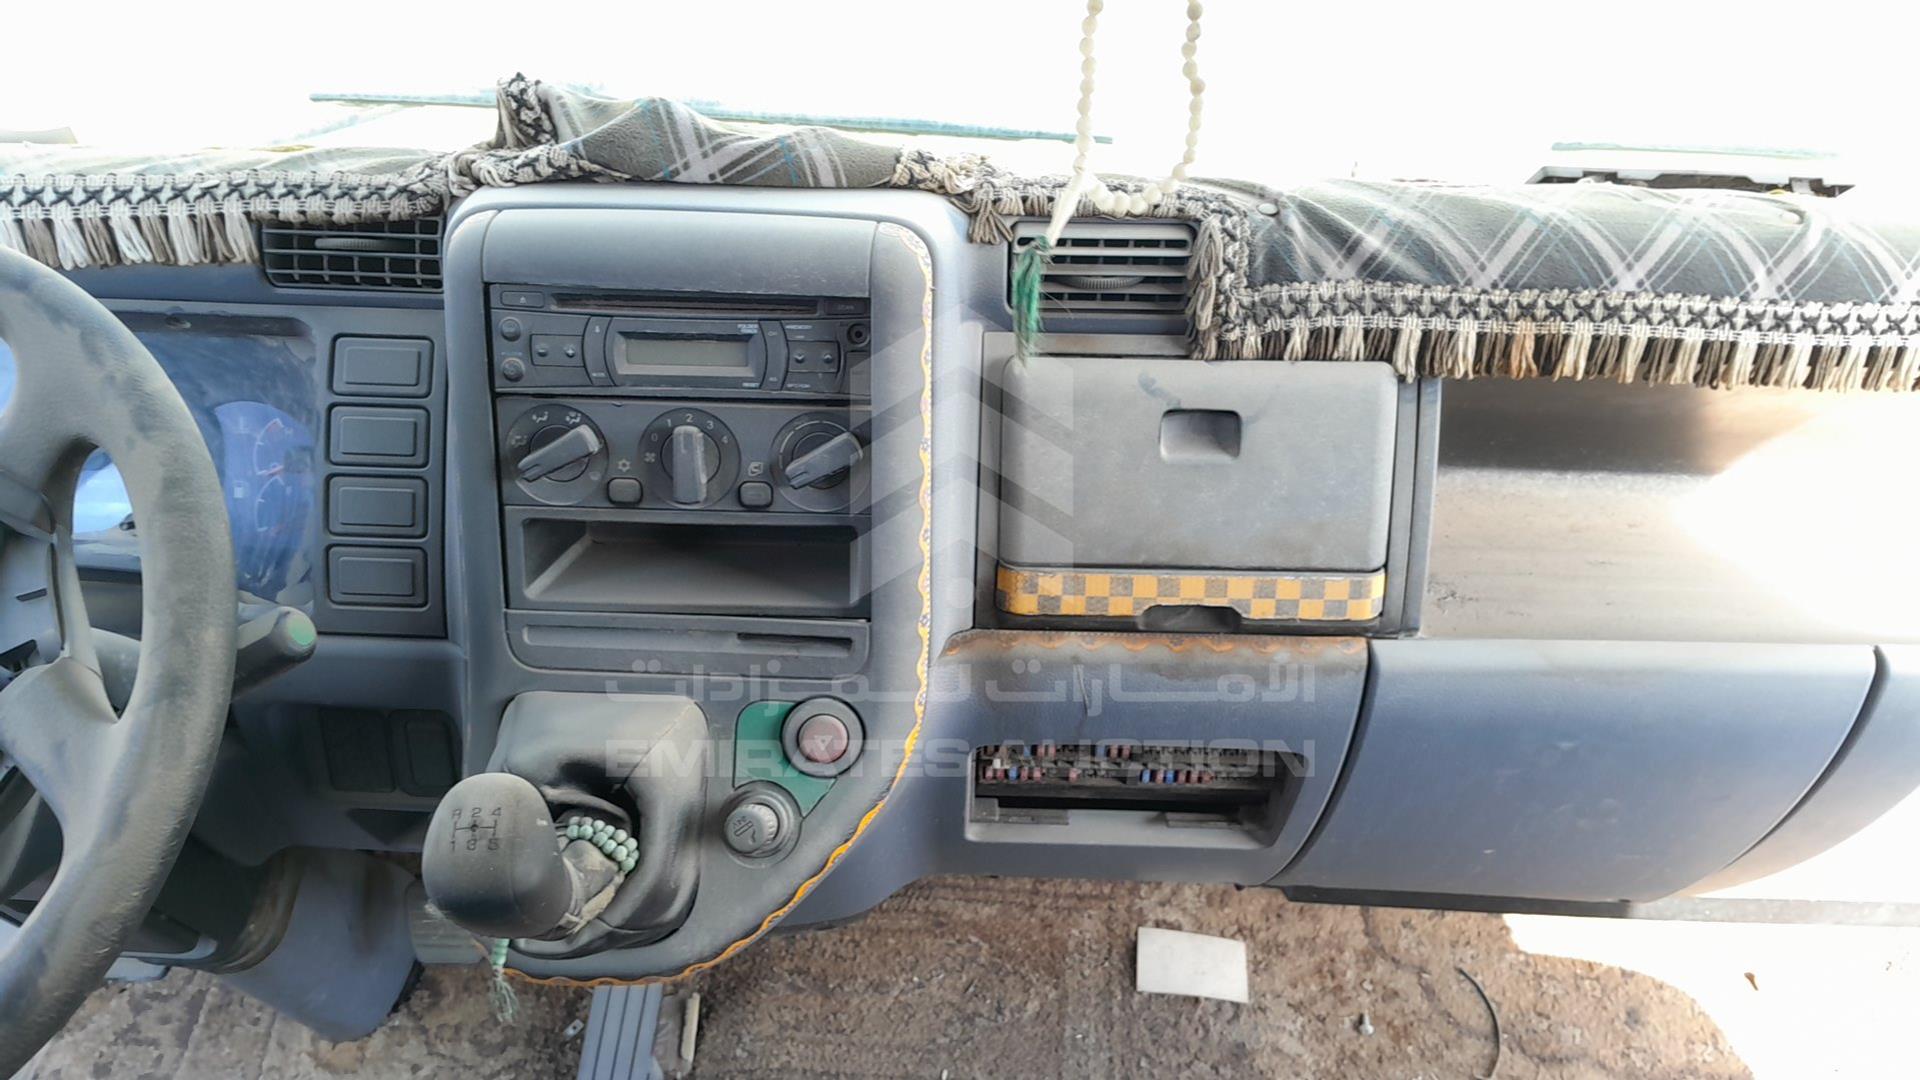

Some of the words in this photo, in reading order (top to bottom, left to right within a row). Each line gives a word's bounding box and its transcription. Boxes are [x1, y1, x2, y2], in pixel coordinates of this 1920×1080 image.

[666, 418, 672, 427] 1
[685, 413, 694, 423] 2
[706, 420, 714, 430] 3
[721, 435, 729, 444] 4
[471, 807, 482, 817] 2
[491, 807, 502, 816] 4
